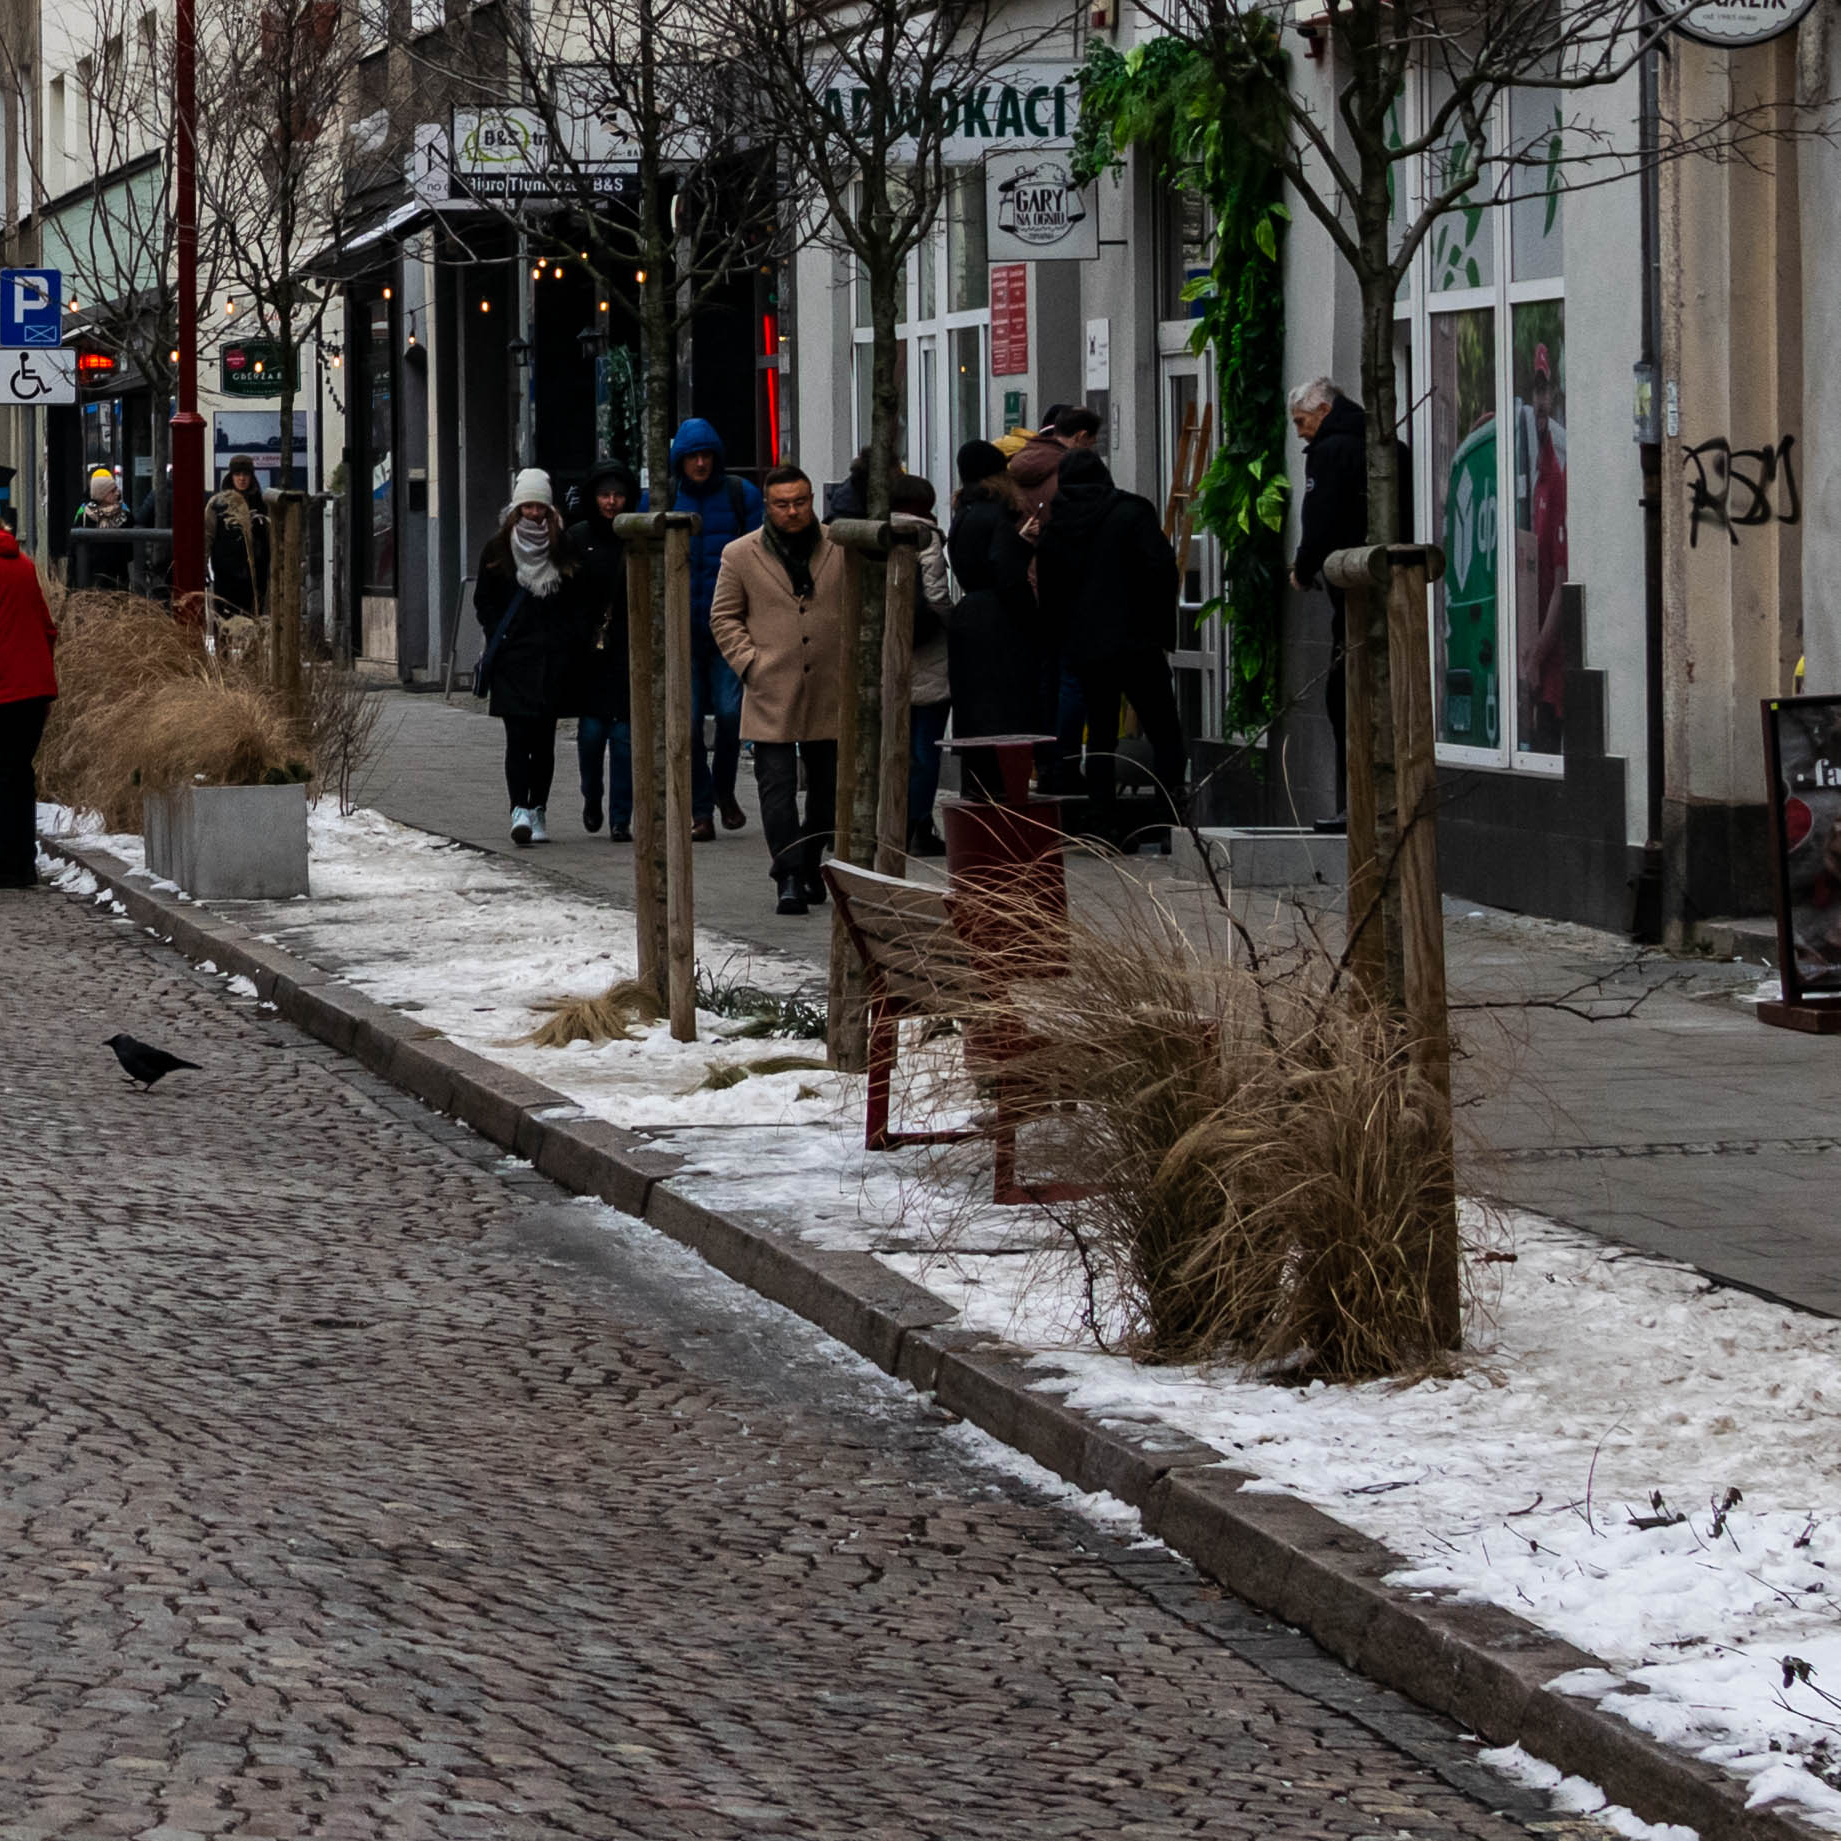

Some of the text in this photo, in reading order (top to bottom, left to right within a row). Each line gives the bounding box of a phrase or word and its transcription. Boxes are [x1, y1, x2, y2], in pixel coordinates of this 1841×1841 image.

[592, 176, 624, 192] B&S
[1015, 188, 1065, 213] GARY
[13, 275, 50, 323] P
